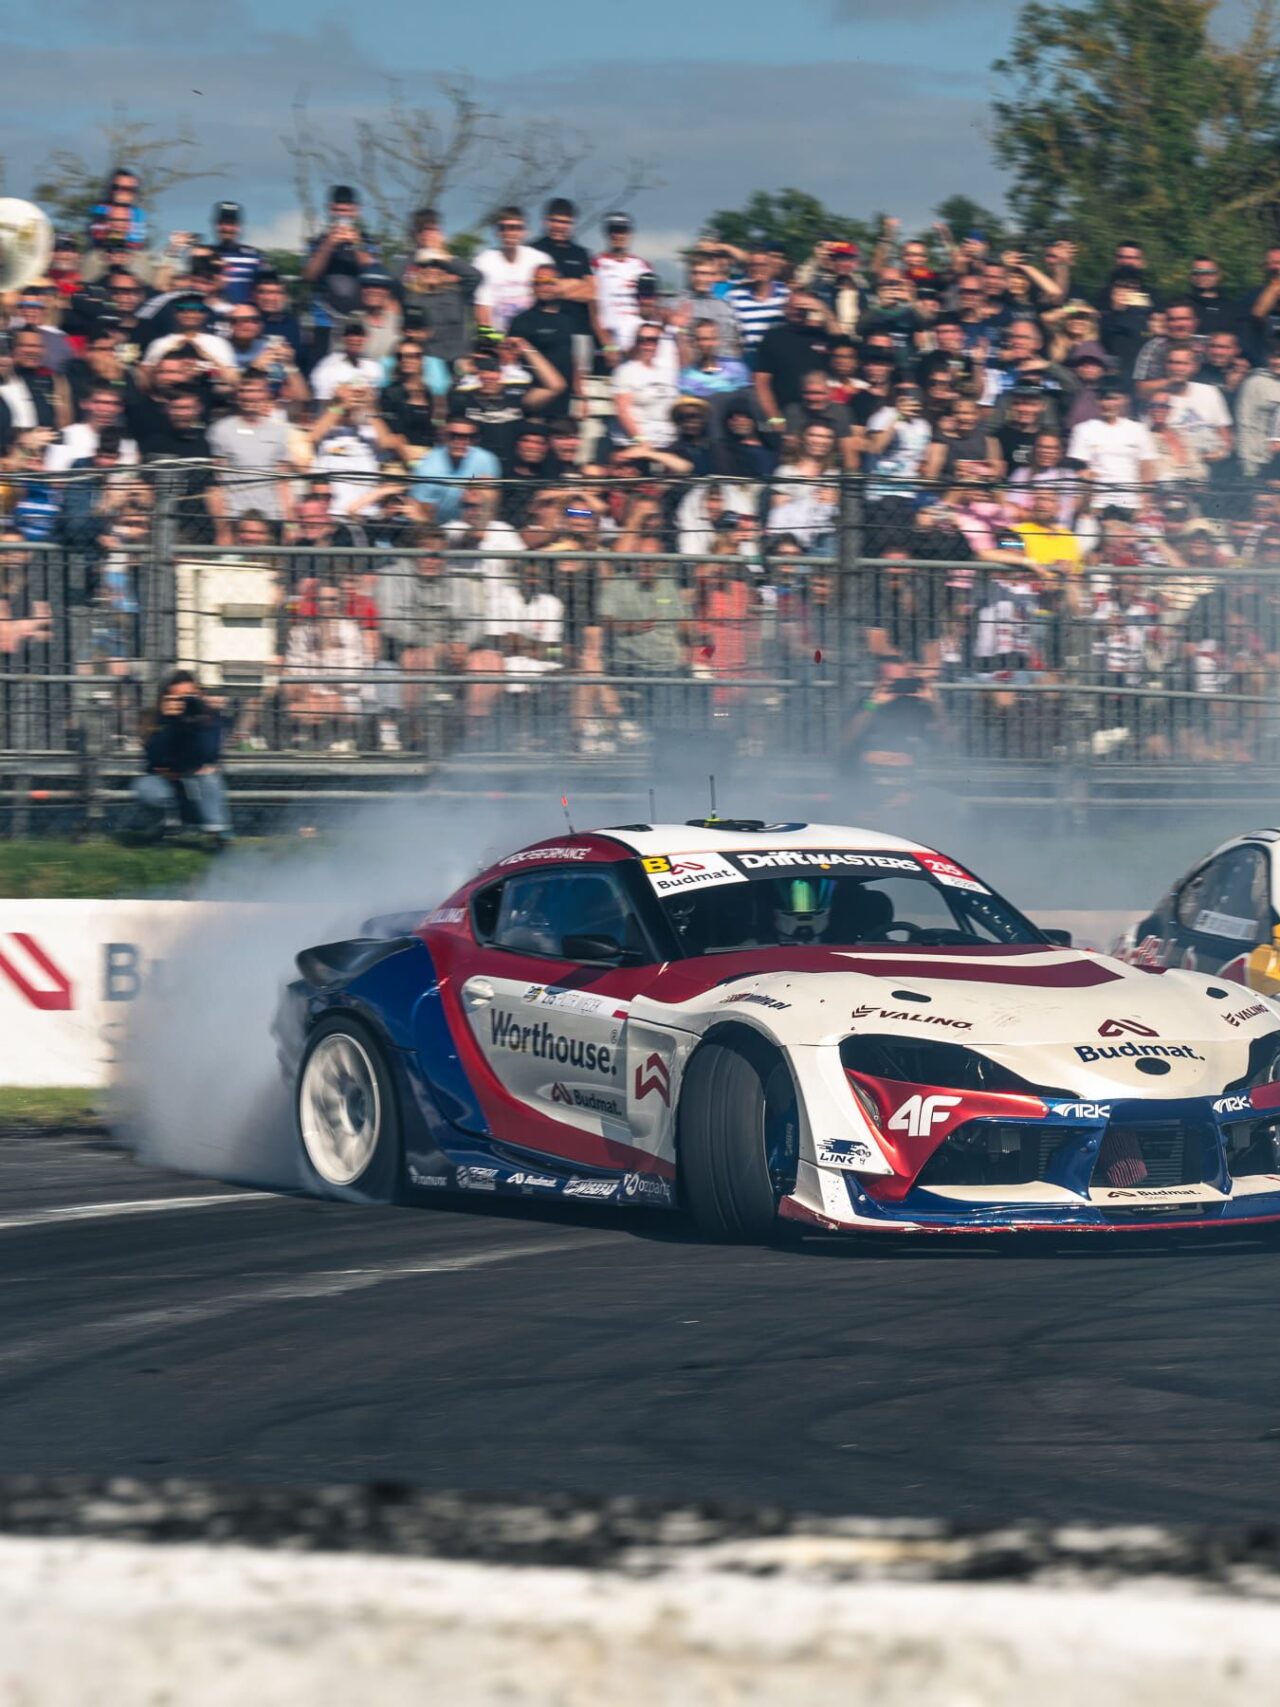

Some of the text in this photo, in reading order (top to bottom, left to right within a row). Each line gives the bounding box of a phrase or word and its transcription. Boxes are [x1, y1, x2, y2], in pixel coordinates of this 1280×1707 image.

[644, 856, 672, 874] B
[656, 869, 736, 890] Budmat.
[880, 1010, 973, 1030] VALINO
[1235, 1004, 1269, 1021] VALINO
[1073, 1041, 1206, 1062] Budmat.
[888, 1095, 963, 1136] 4F
